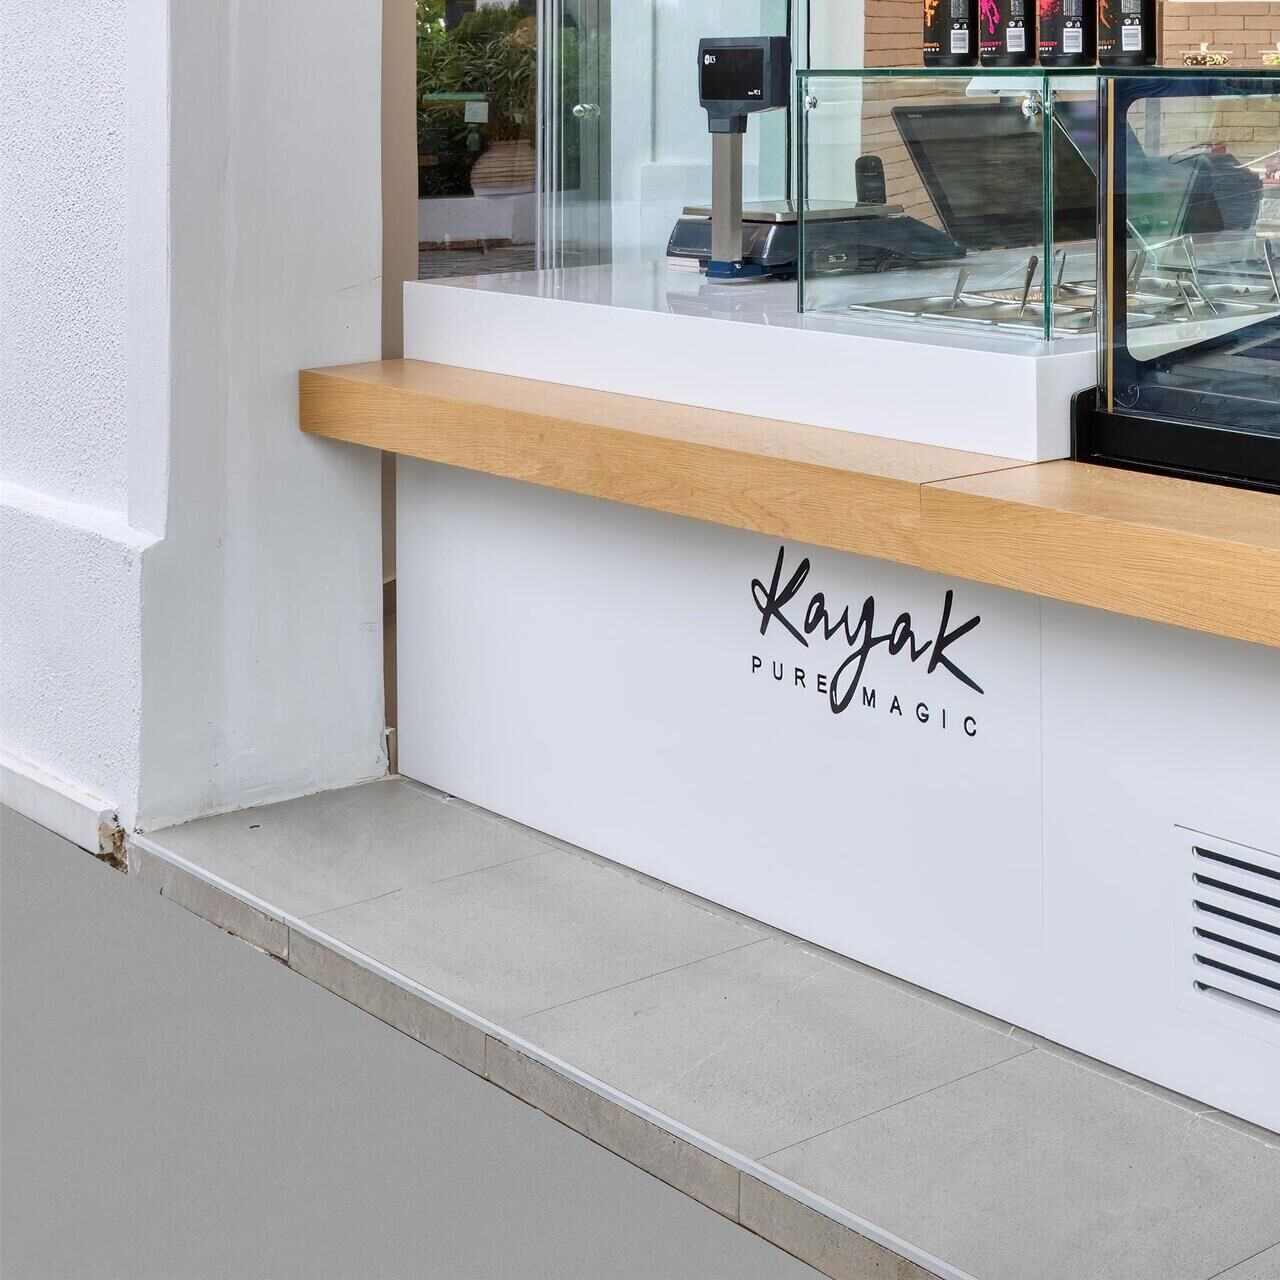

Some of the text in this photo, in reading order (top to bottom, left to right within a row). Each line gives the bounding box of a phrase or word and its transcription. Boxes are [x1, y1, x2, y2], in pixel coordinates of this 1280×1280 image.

[751, 545, 984, 714] Kayak
[751, 655, 977, 737] PURE MAGIC
